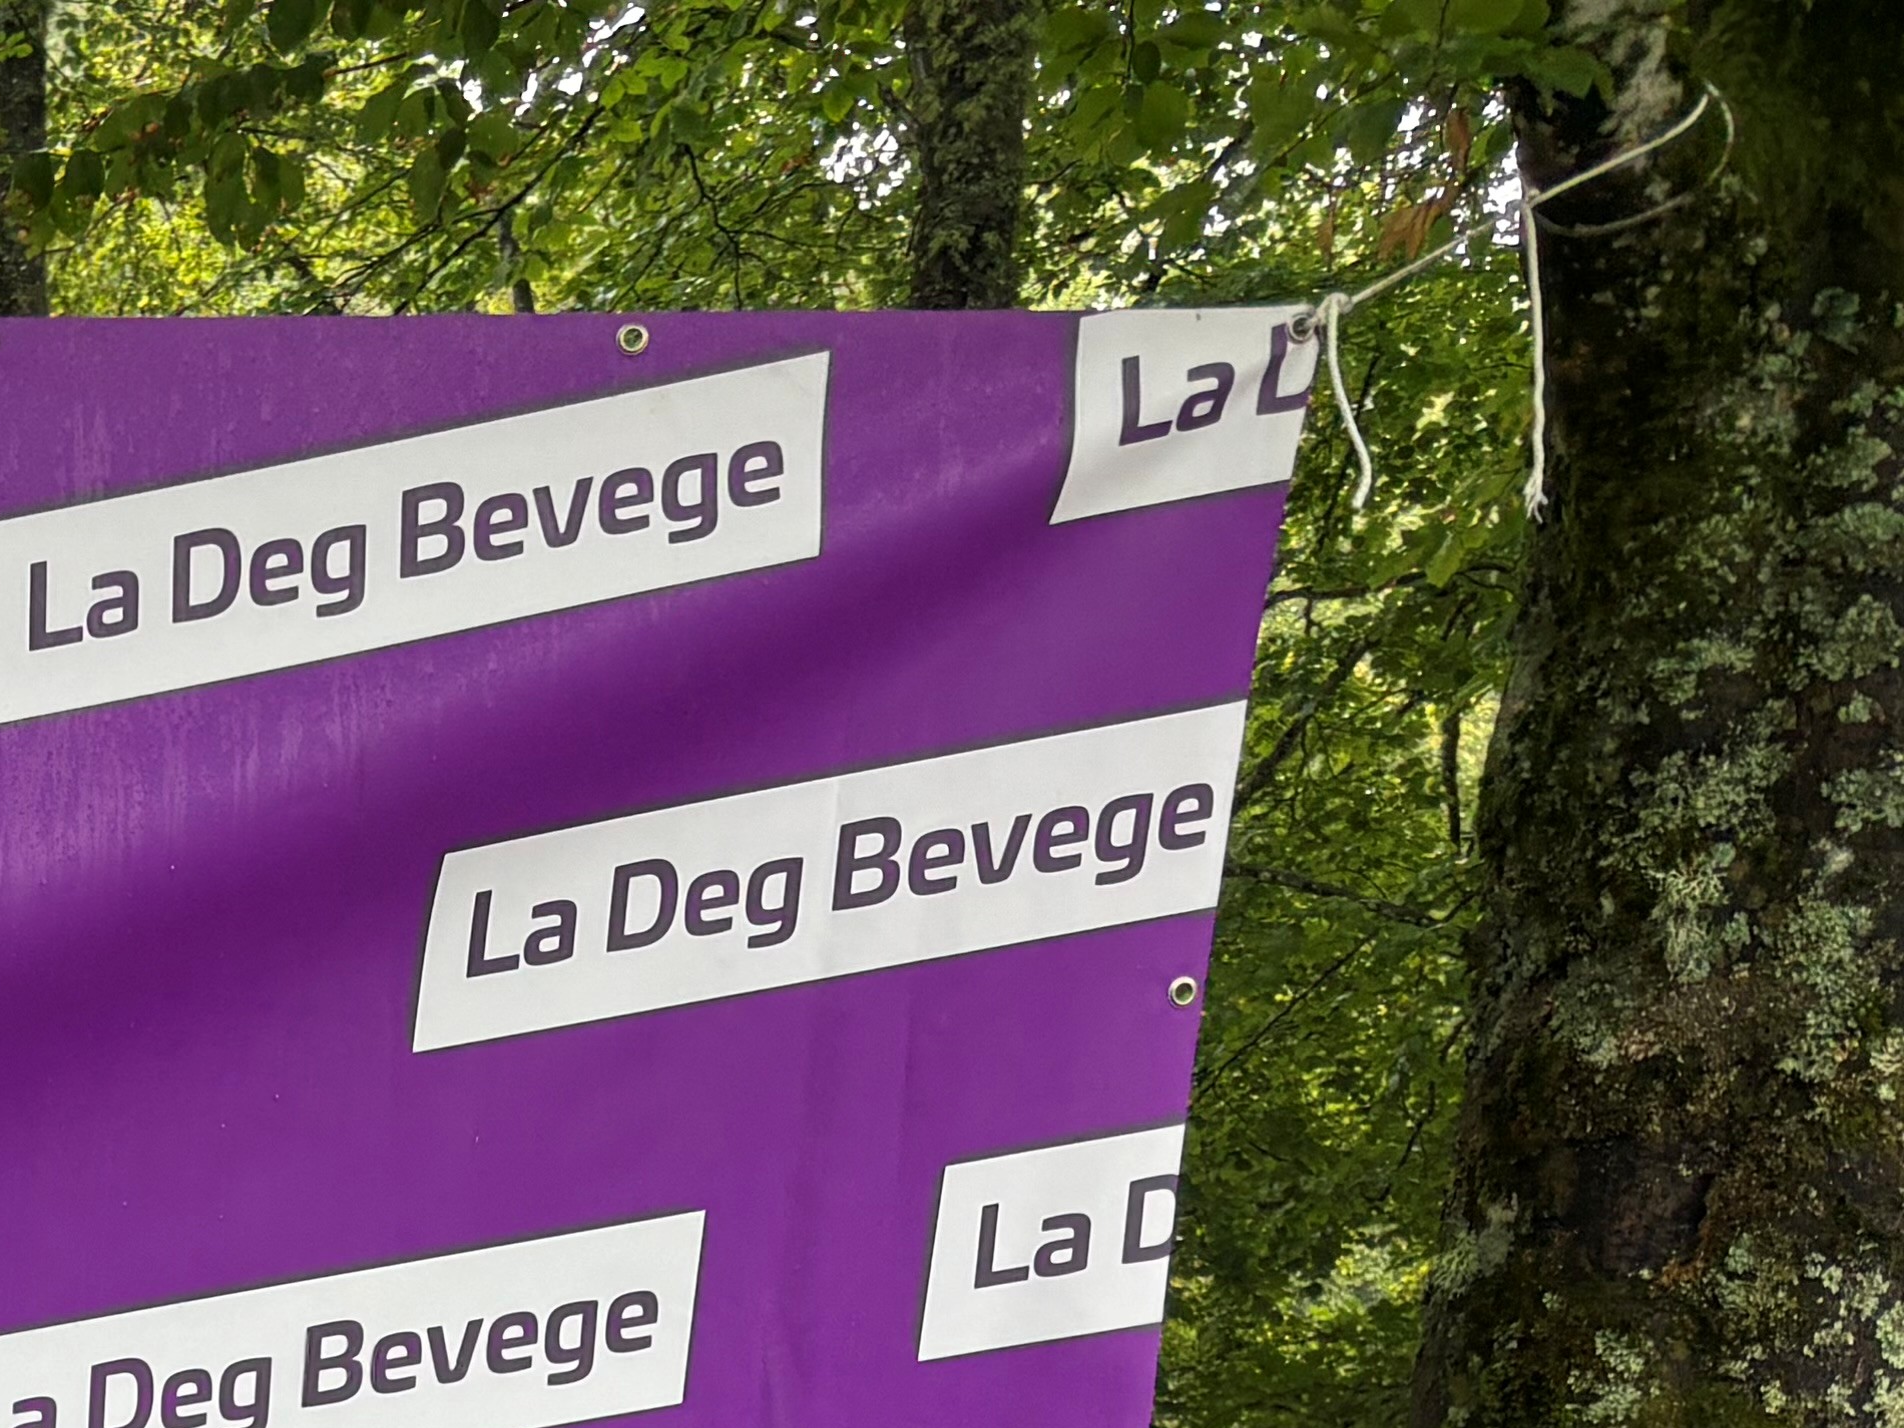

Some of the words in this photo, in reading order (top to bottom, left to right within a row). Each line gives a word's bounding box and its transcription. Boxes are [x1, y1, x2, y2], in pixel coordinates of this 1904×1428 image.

[1119, 356, 1235, 446] La
[29, 561, 139, 651] La
[173, 525, 366, 623] Deg
[400, 441, 783, 578] Bevege
[466, 890, 577, 978] La
[607, 857, 803, 952] Deg
[832, 784, 1213, 911] Bevege
[974, 1203, 1091, 1289] La
[302, 1291, 658, 1407] Bevege
